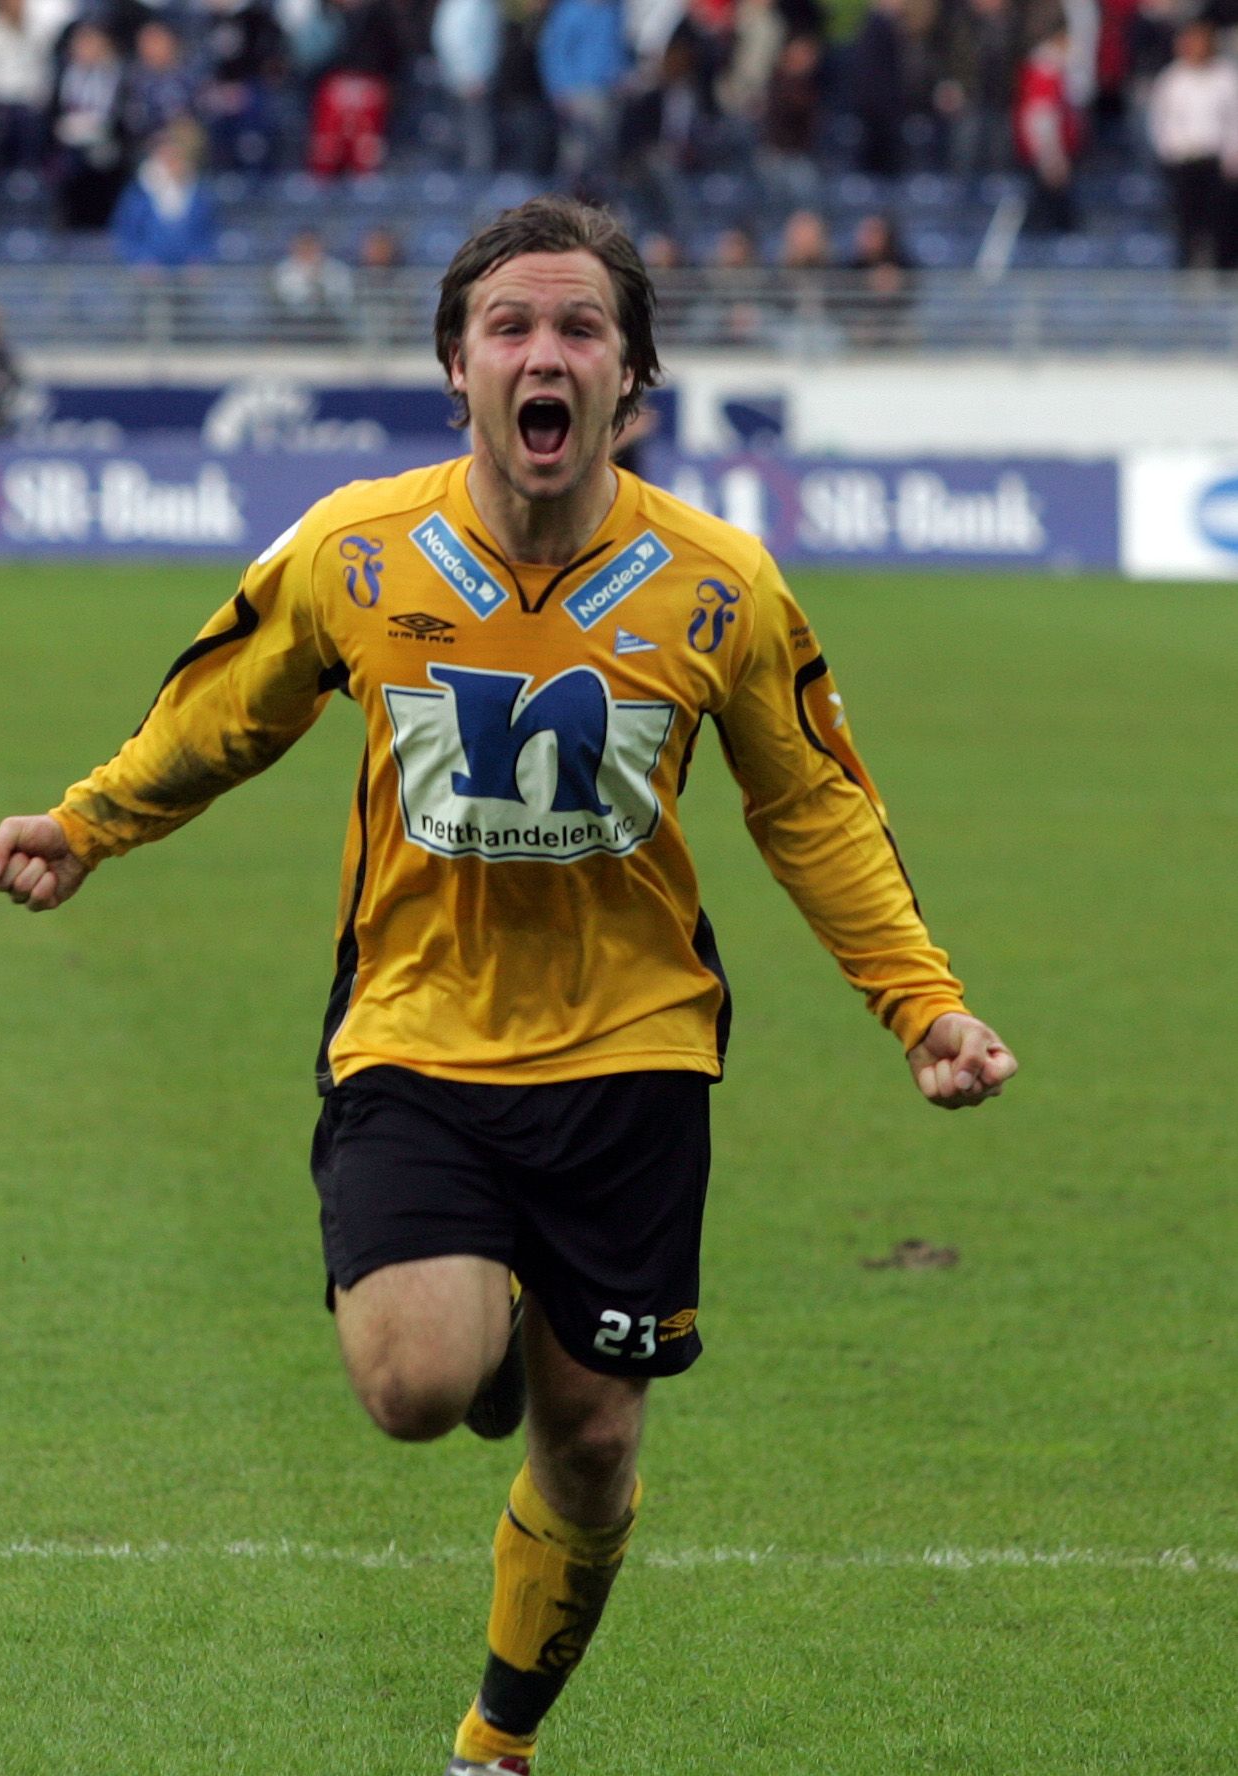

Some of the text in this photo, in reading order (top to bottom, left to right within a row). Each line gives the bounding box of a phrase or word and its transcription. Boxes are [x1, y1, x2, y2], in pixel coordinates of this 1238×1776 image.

[421, 526, 477, 594] Nordea
[577, 560, 645, 618] Nordea
[422, 814, 635, 847] netthandelen.no
[593, 1309, 657, 1358] 23
